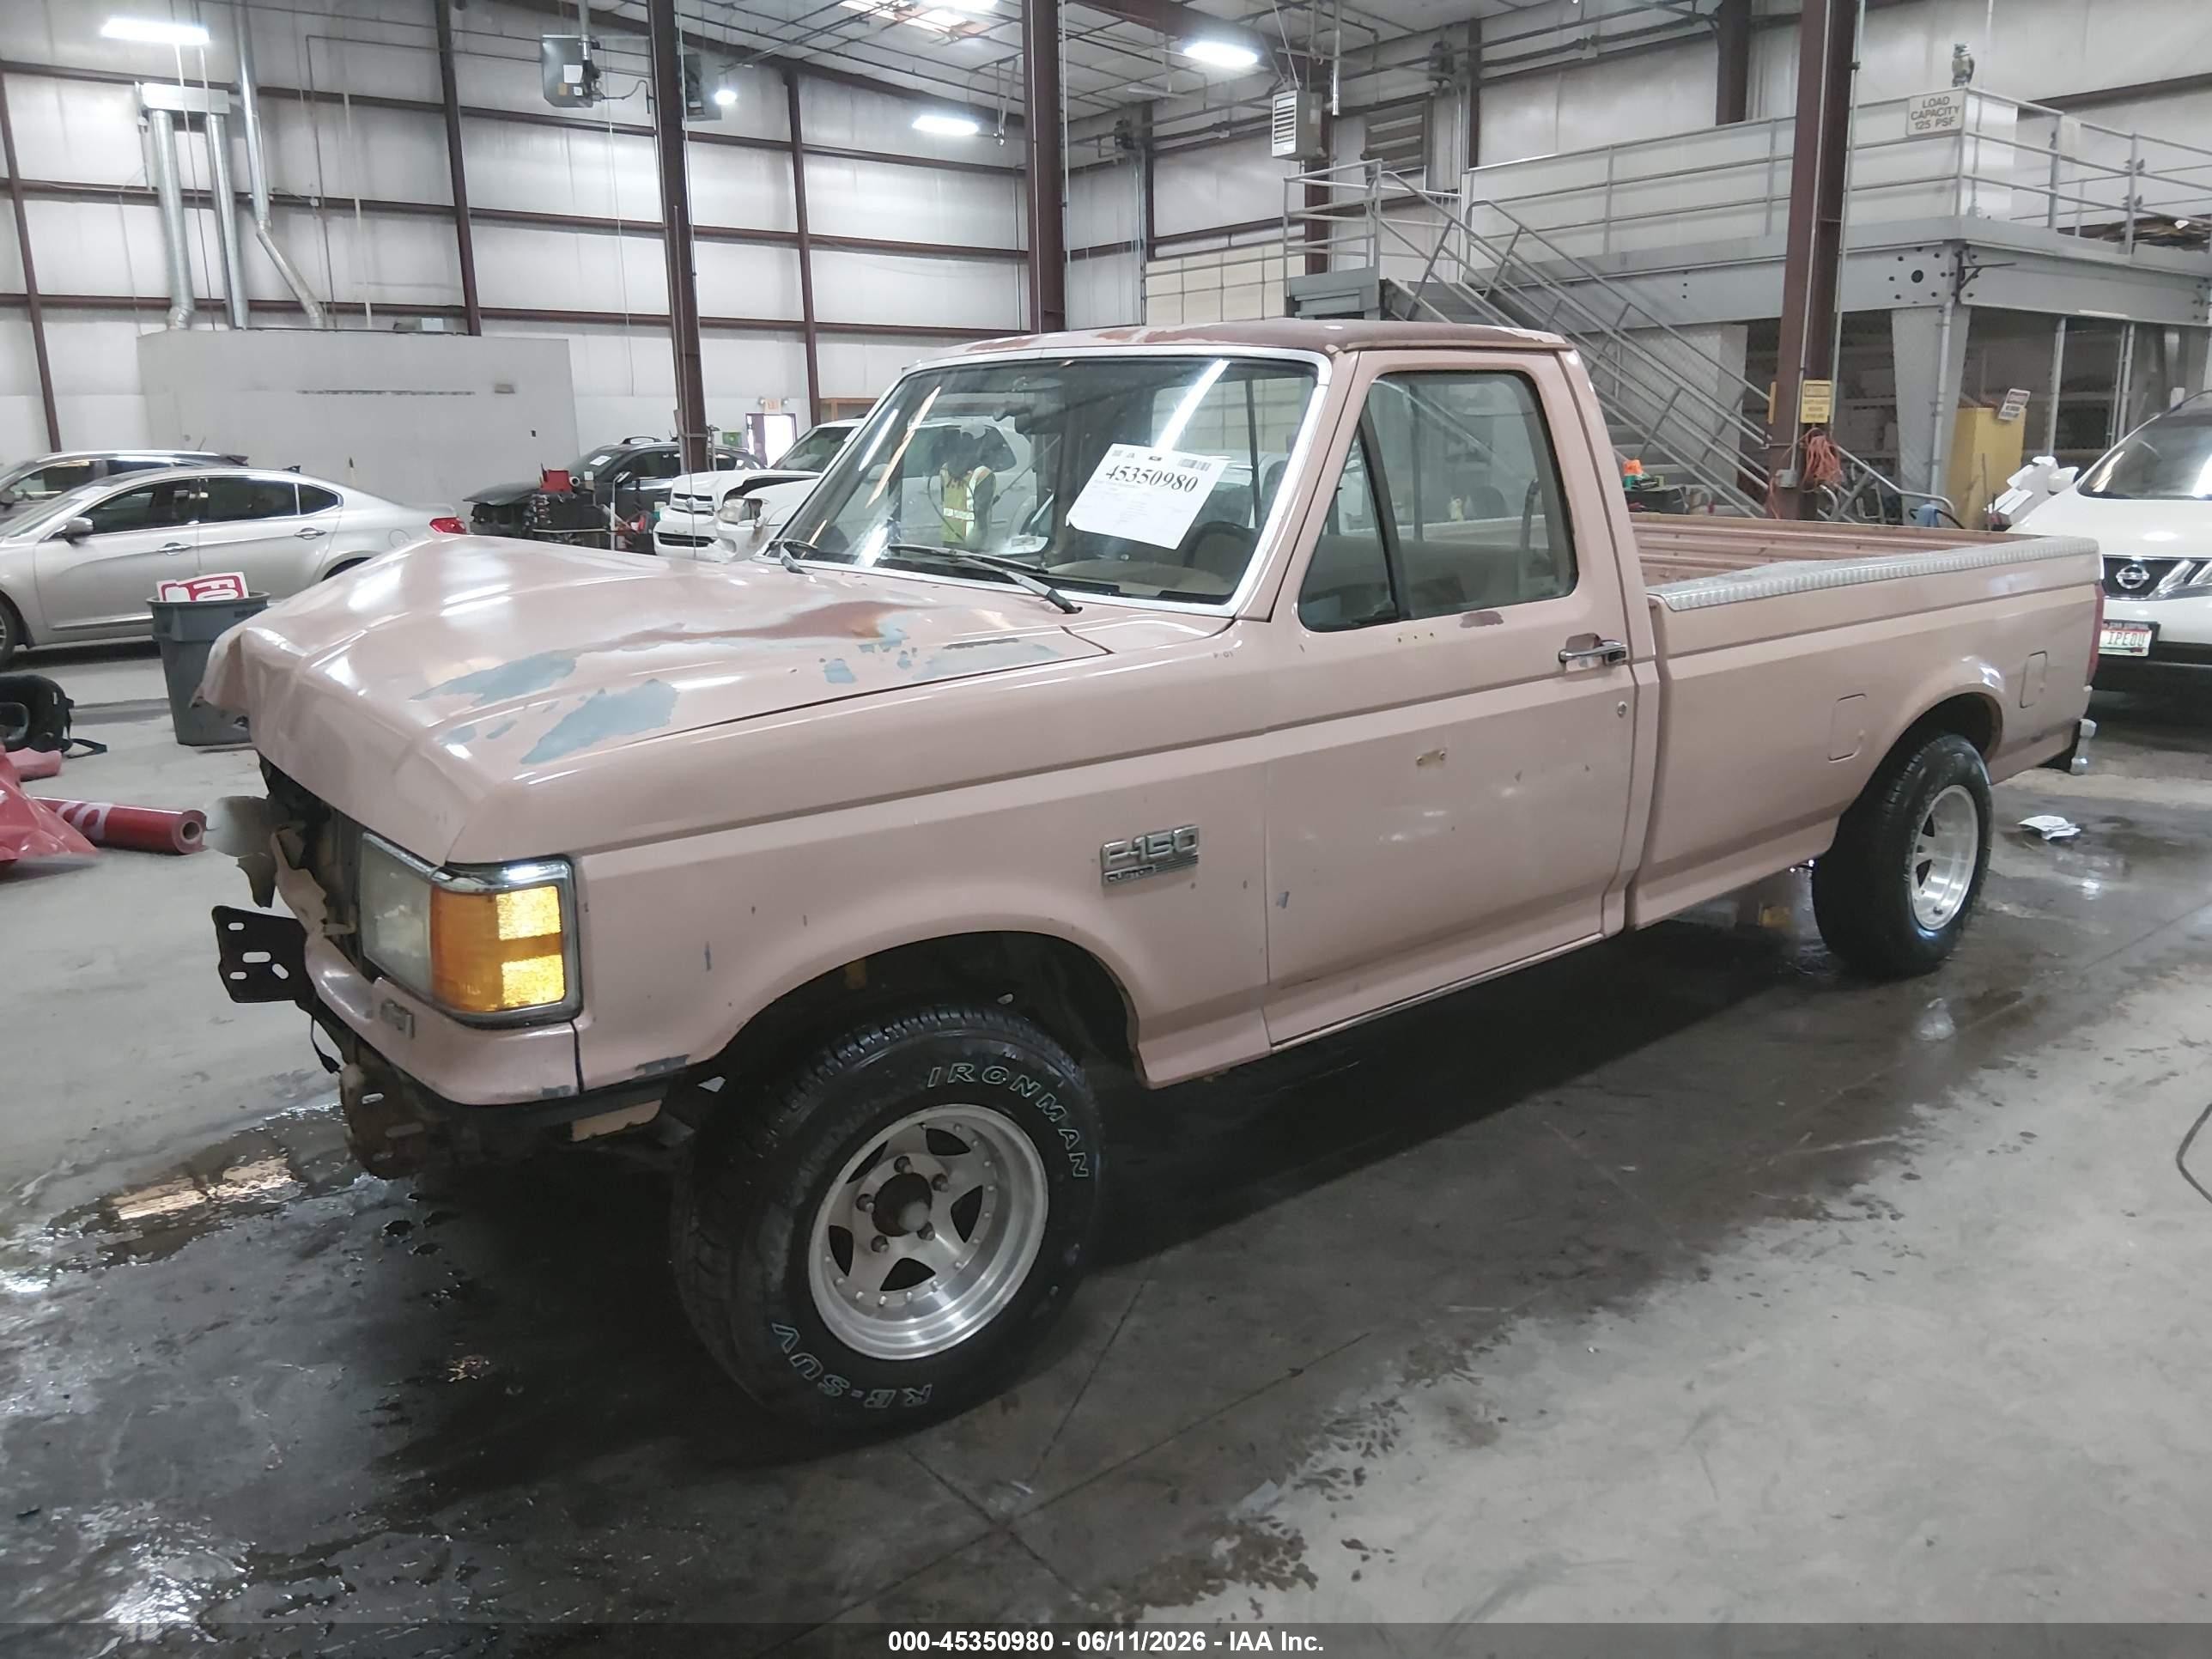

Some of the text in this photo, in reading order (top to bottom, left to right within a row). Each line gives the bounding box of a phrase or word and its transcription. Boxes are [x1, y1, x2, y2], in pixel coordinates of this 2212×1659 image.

[1911, 106, 1960, 120] CAPACITY
[1922, 95, 1950, 109] LOAD
[1914, 116, 1955, 131] 125 PSF
[1105, 465, 1199, 493] 45350980
[1100, 824, 1200, 867] F-150
[927, 1062, 1090, 1177] IRONMAN
[771, 1322, 933, 1408] RB-SUV
